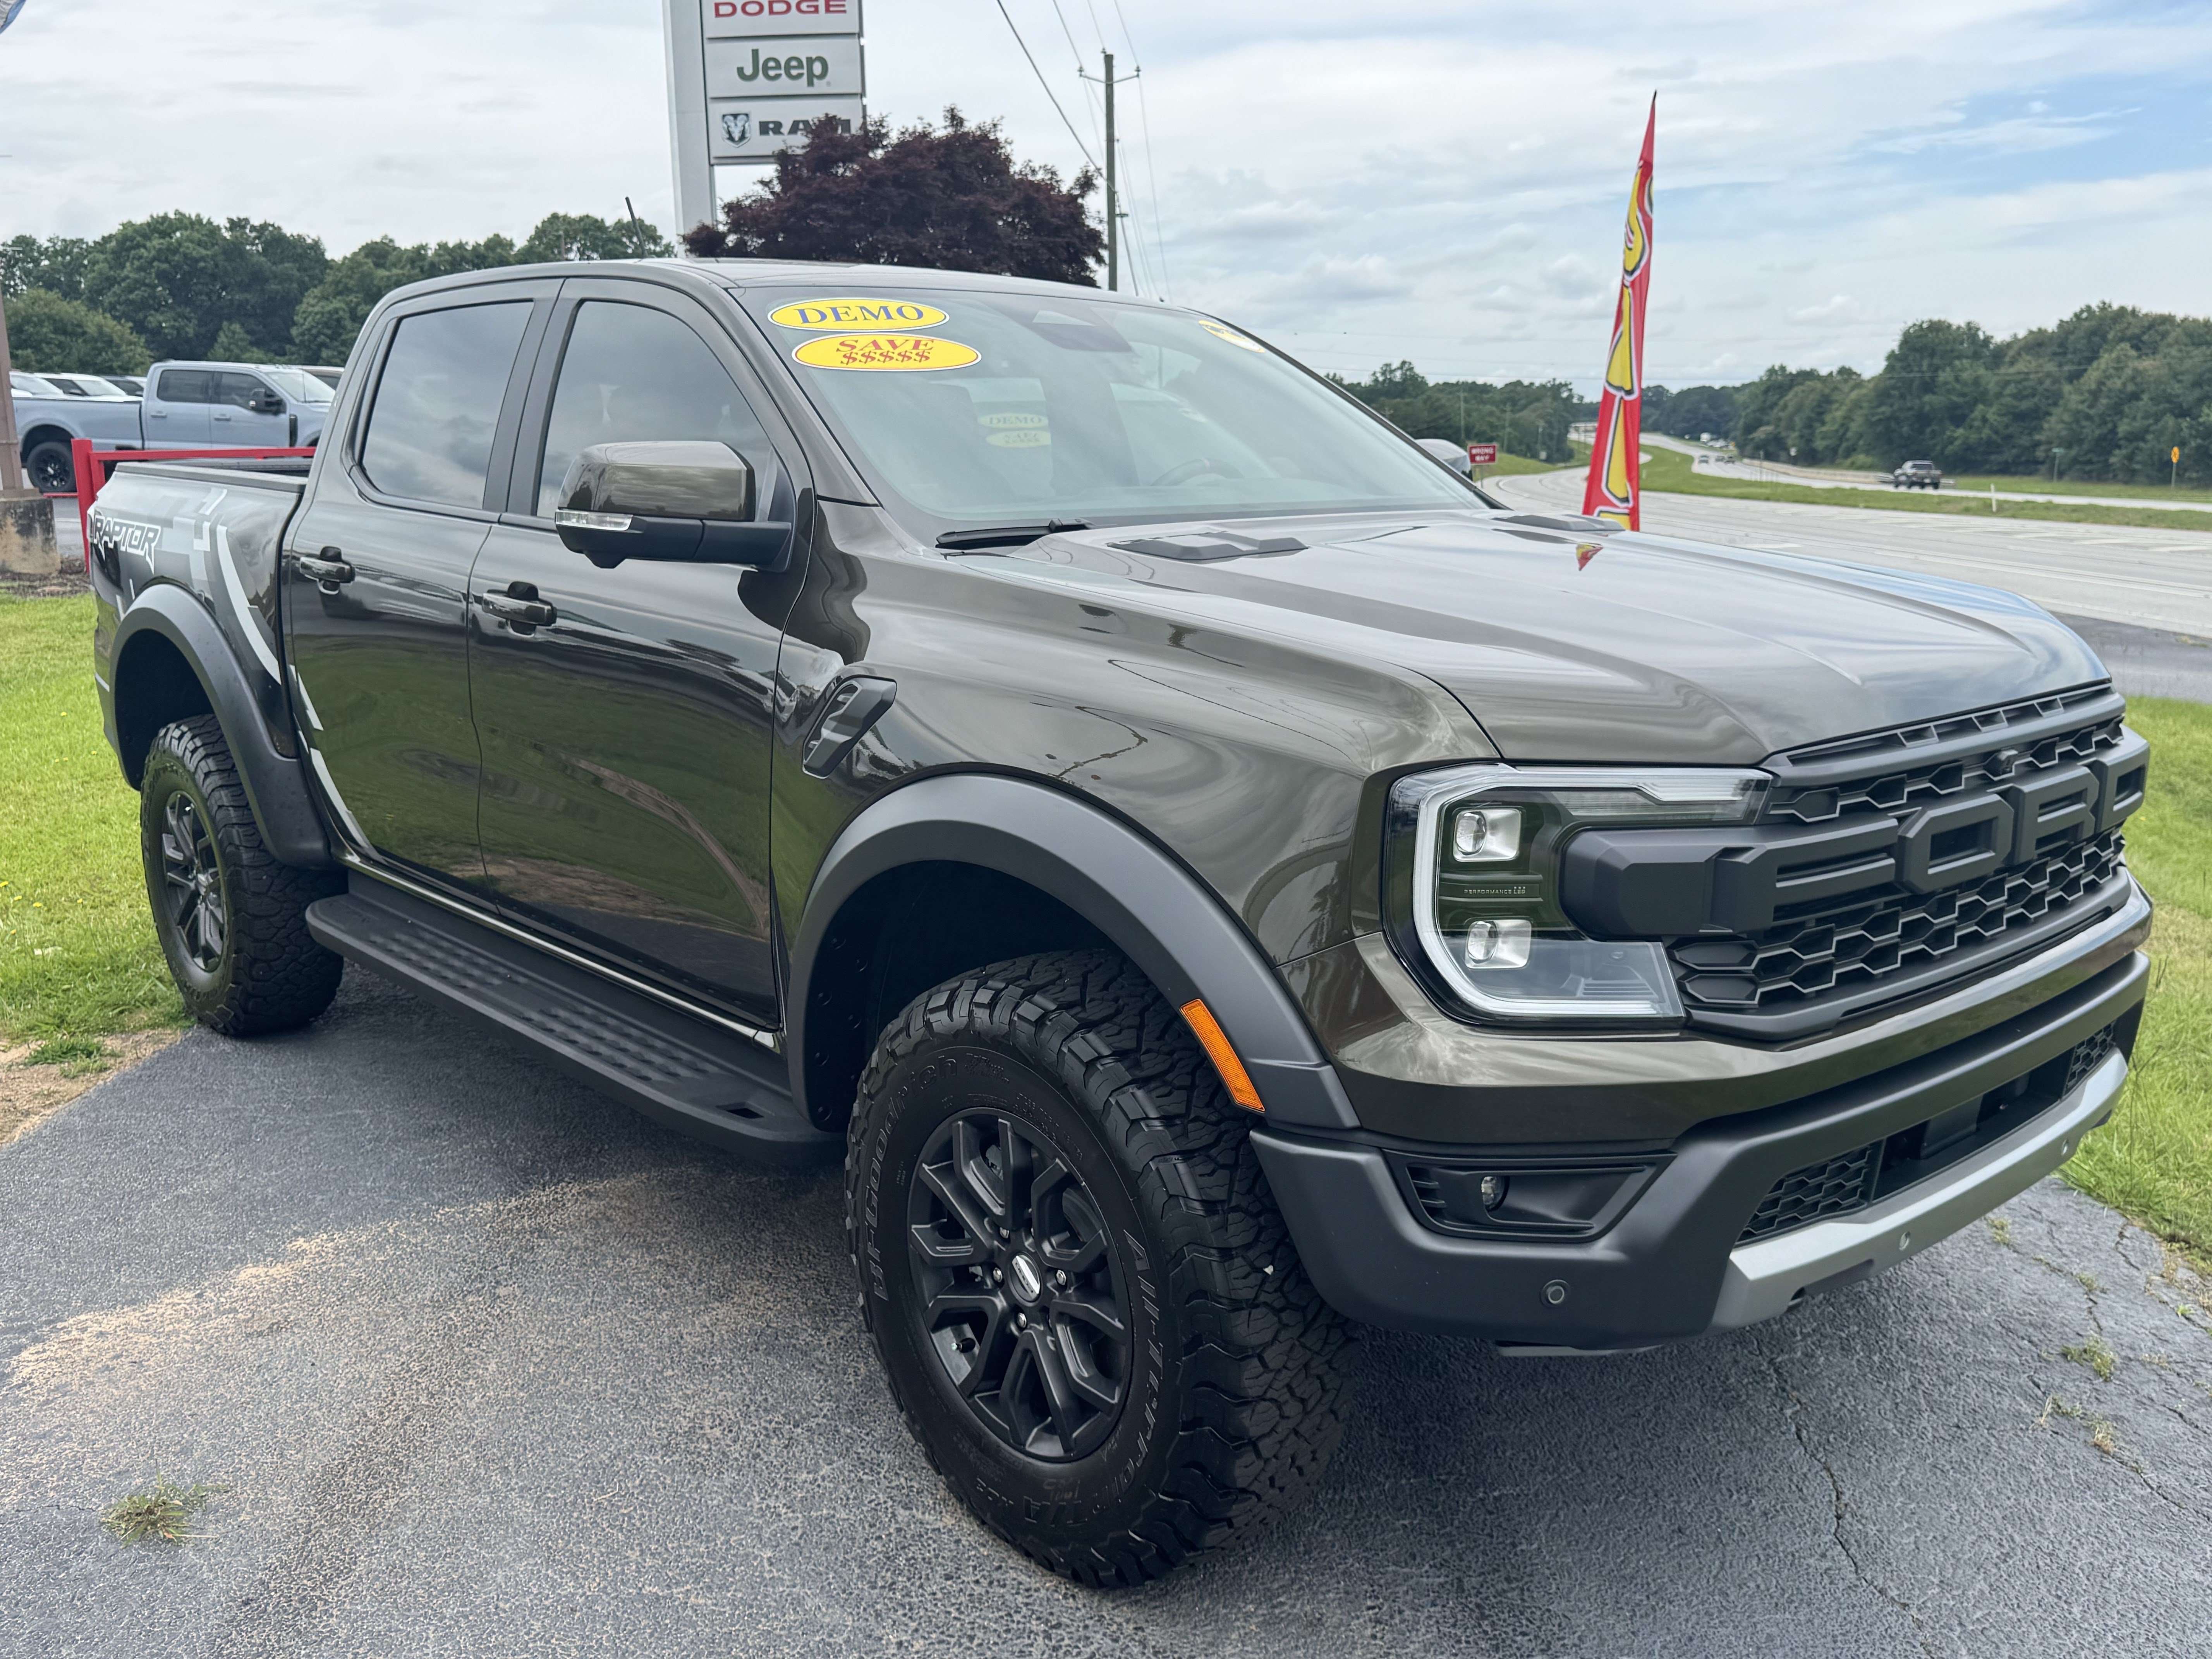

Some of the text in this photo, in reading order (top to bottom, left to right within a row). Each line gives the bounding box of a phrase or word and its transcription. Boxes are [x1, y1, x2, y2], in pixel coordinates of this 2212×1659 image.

[714, 0, 847, 18] DODGE
[737, 49, 829, 87] Jeep
[793, 305, 924, 325] DEMO
[836, 339, 934, 352] SAVE
[840, 350, 931, 366] $$$$$
[989, 416, 1042, 425] DEMO
[93, 515, 161, 575] RAPTOR
[1705, 728, 2150, 932] FORD
[865, 1055, 958, 1302] BFGoodrich
